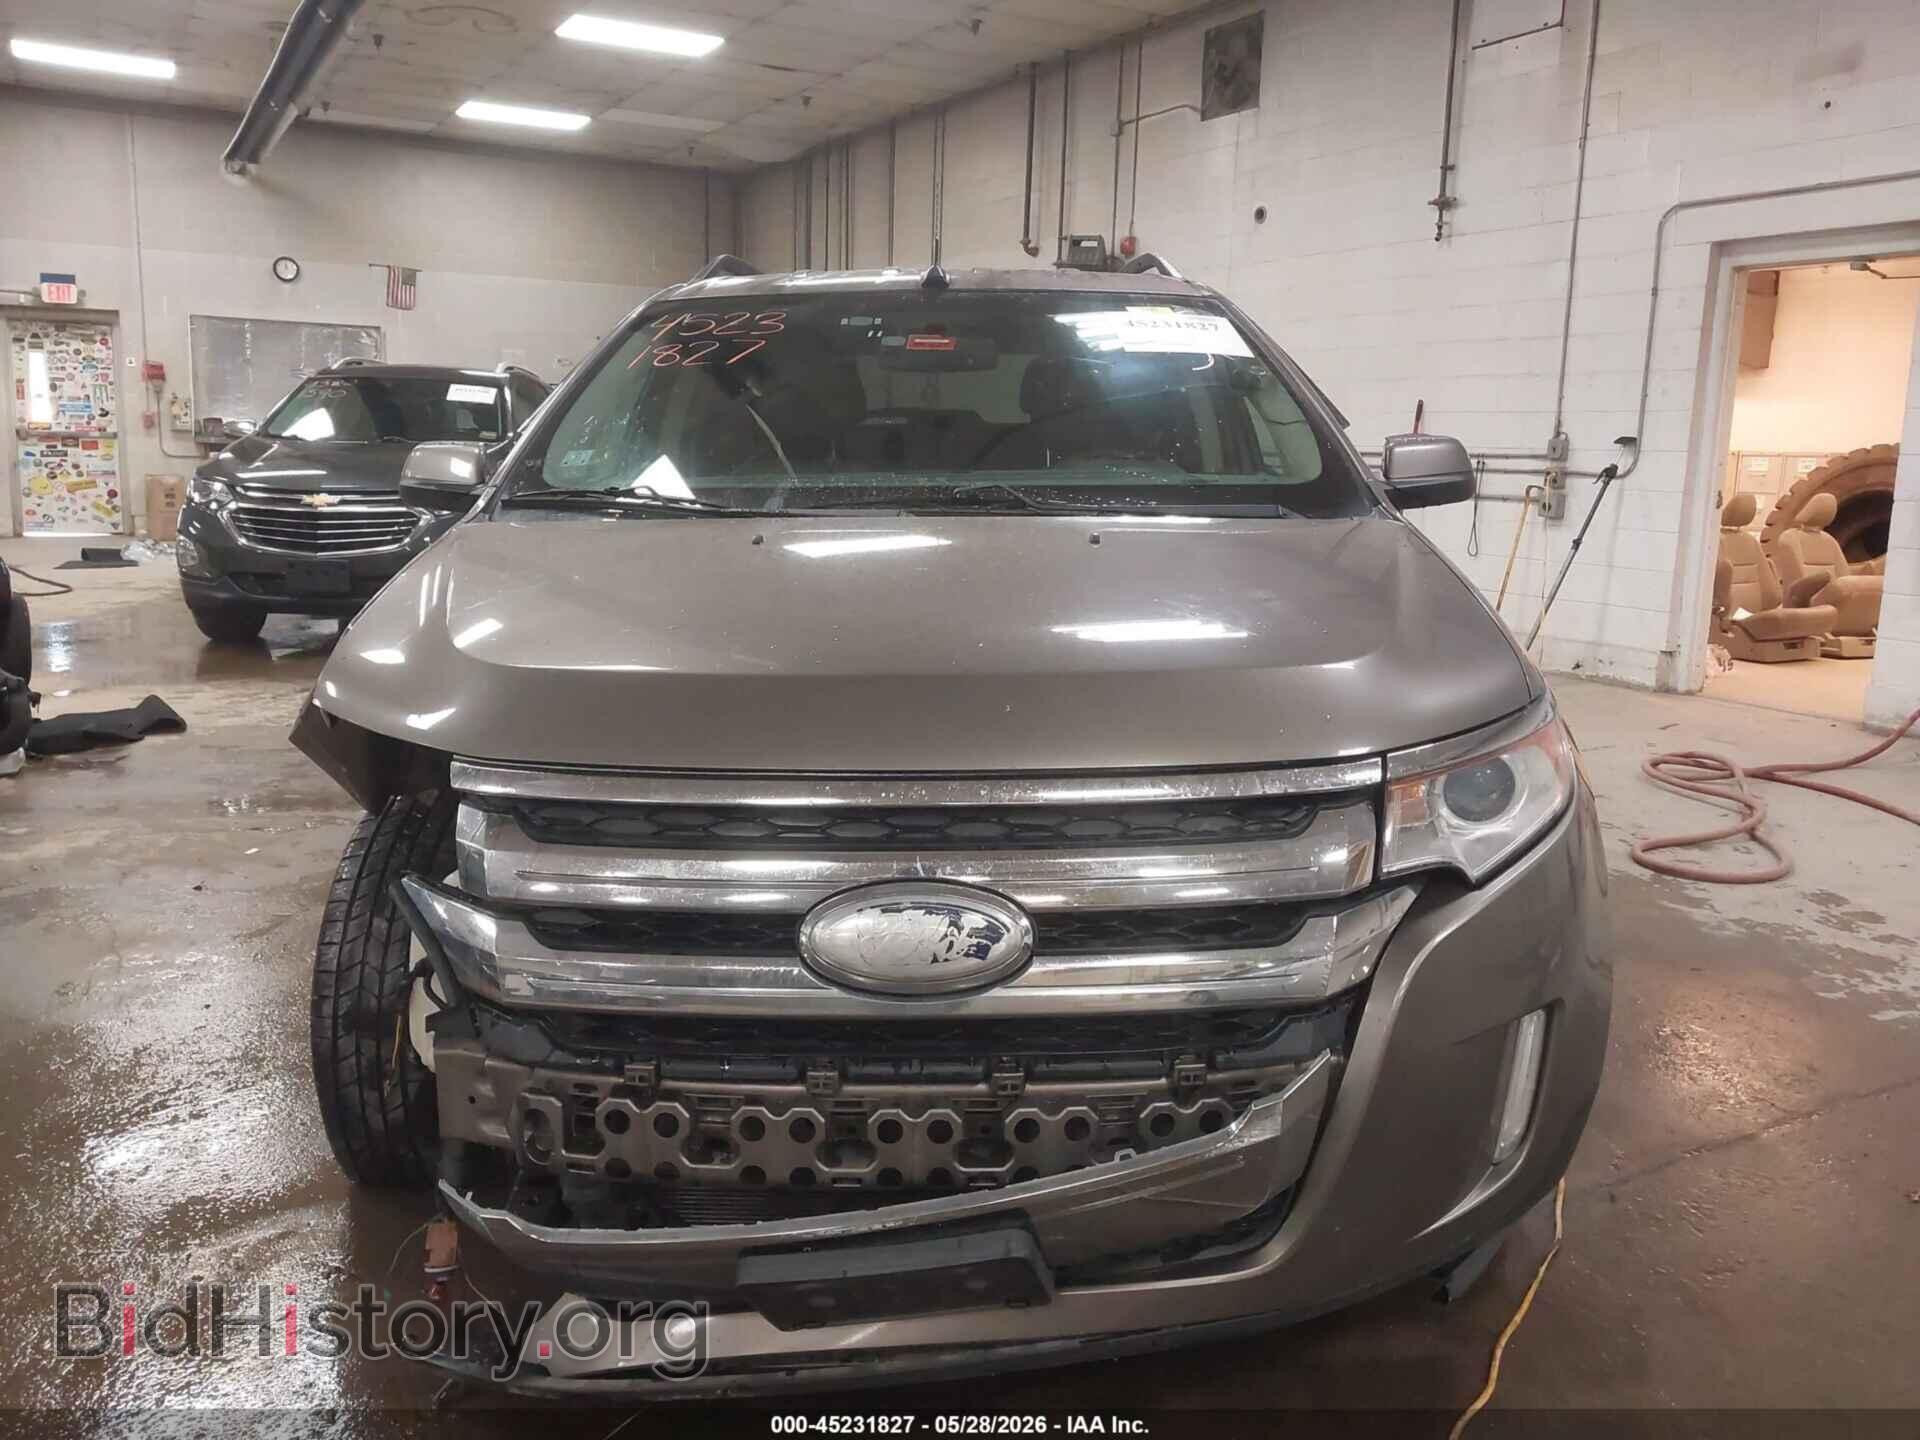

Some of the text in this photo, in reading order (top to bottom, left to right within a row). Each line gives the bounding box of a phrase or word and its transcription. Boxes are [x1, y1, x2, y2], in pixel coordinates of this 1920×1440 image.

[47, 284, 73, 300] EXIT
[650, 311, 788, 342] 4523
[627, 339, 767, 369] 1827
